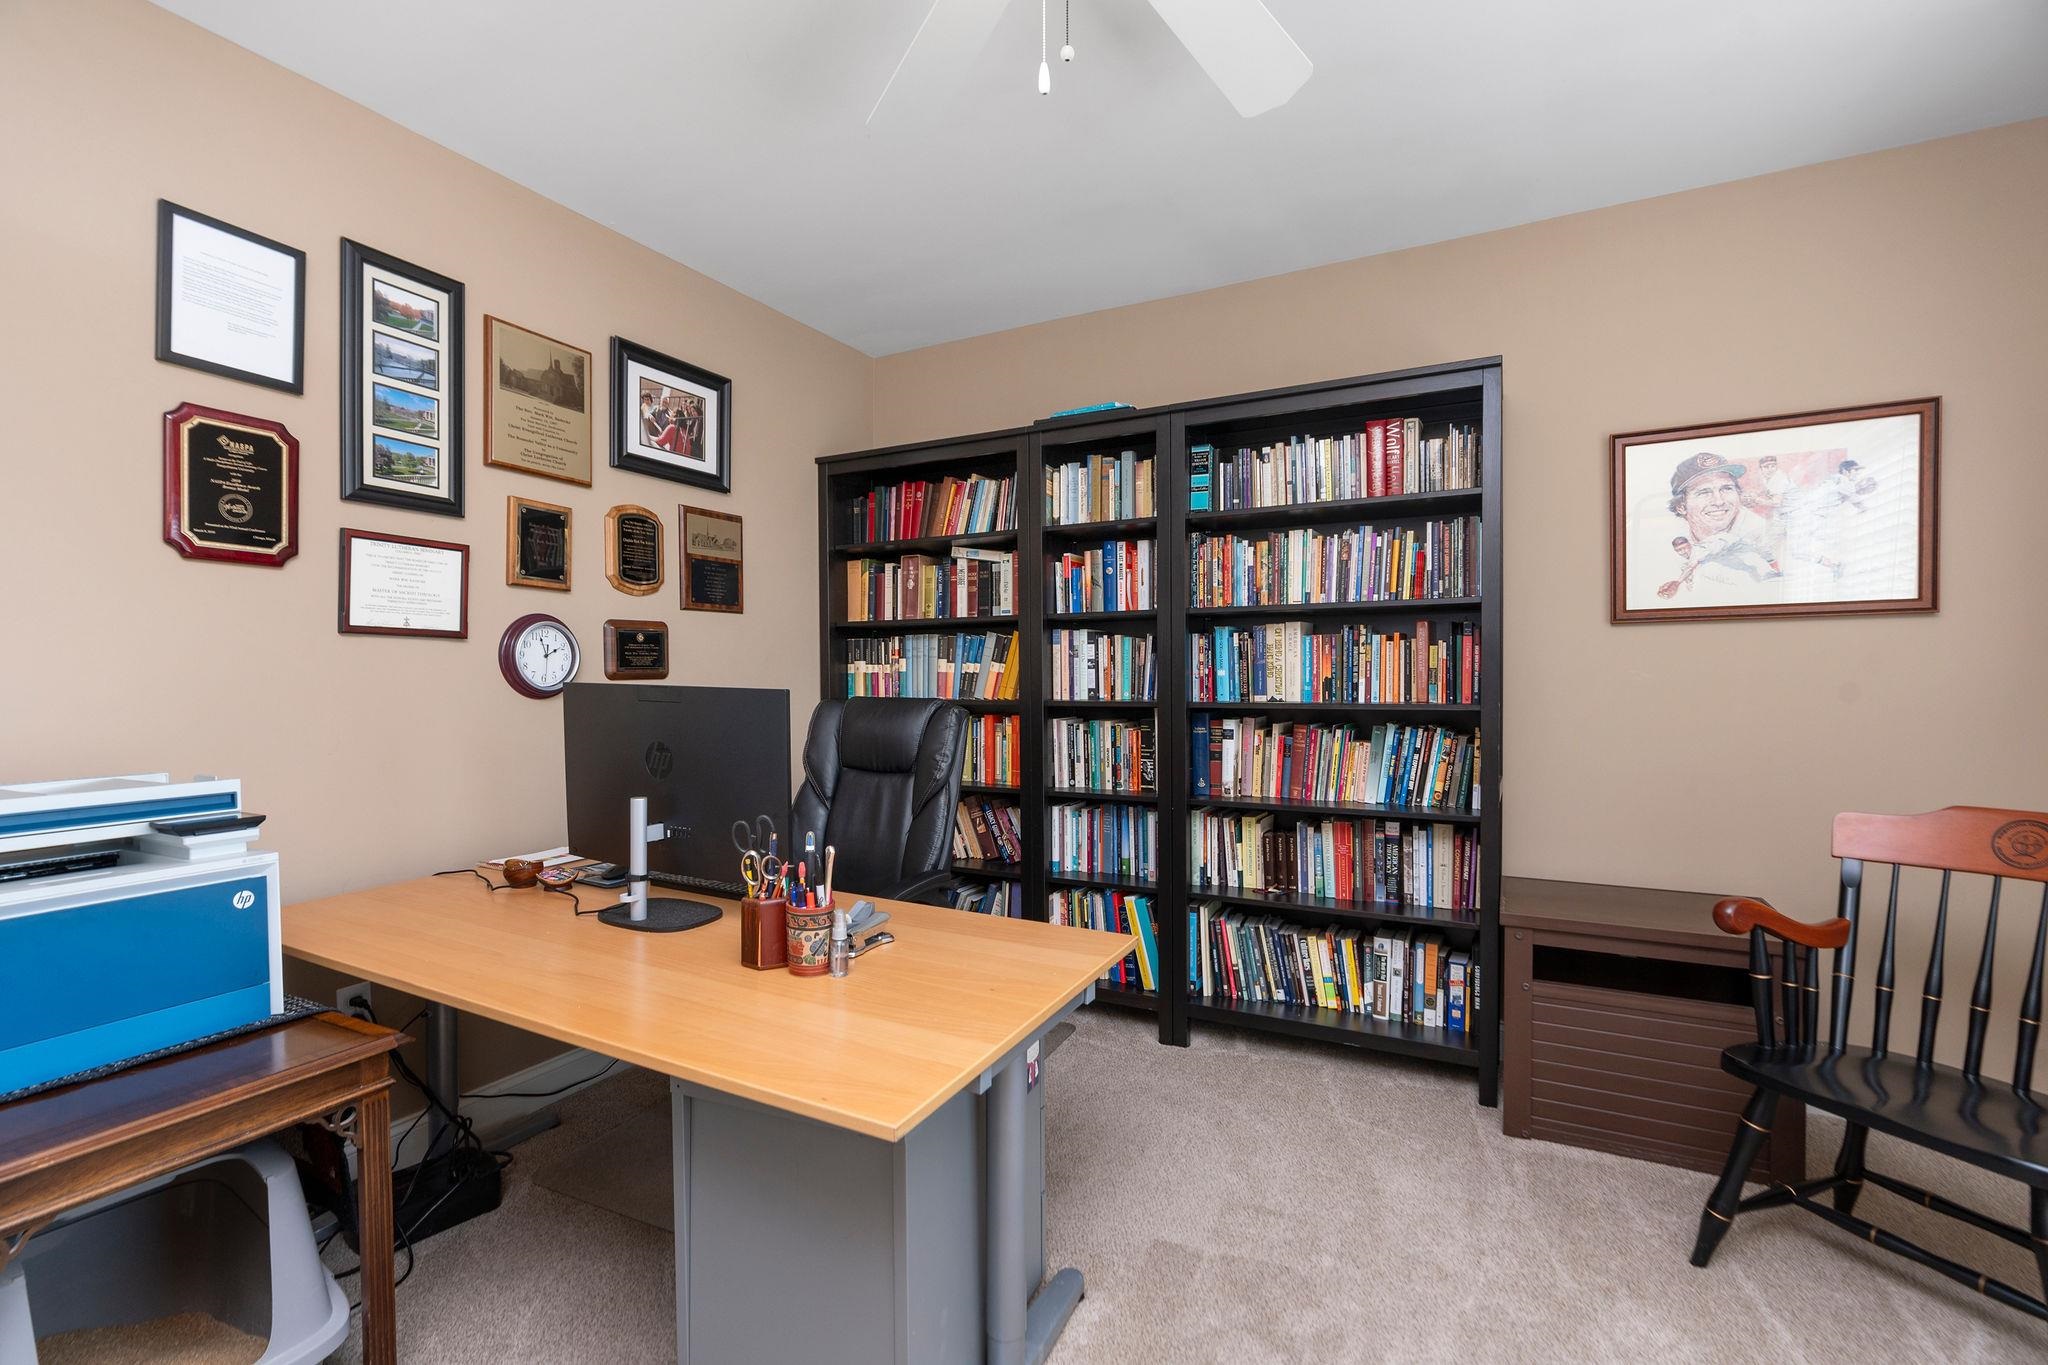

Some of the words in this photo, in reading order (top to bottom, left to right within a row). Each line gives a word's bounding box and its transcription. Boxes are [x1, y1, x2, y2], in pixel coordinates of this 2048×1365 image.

[1386, 421, 1401, 454] Wolf
[229, 440, 254, 452] NASPA
[531, 632, 538, 640] 11
[1275, 628, 1283, 637] ON
[531, 671, 536, 679] 7
[542, 674, 546, 682] 6
[650, 742, 672, 780] hp
[986, 810, 996, 824] LEGACY
[992, 824, 1000, 837] GUIDE
[237, 890, 252, 909] hp
[1300, 940, 1308, 958] Culture
